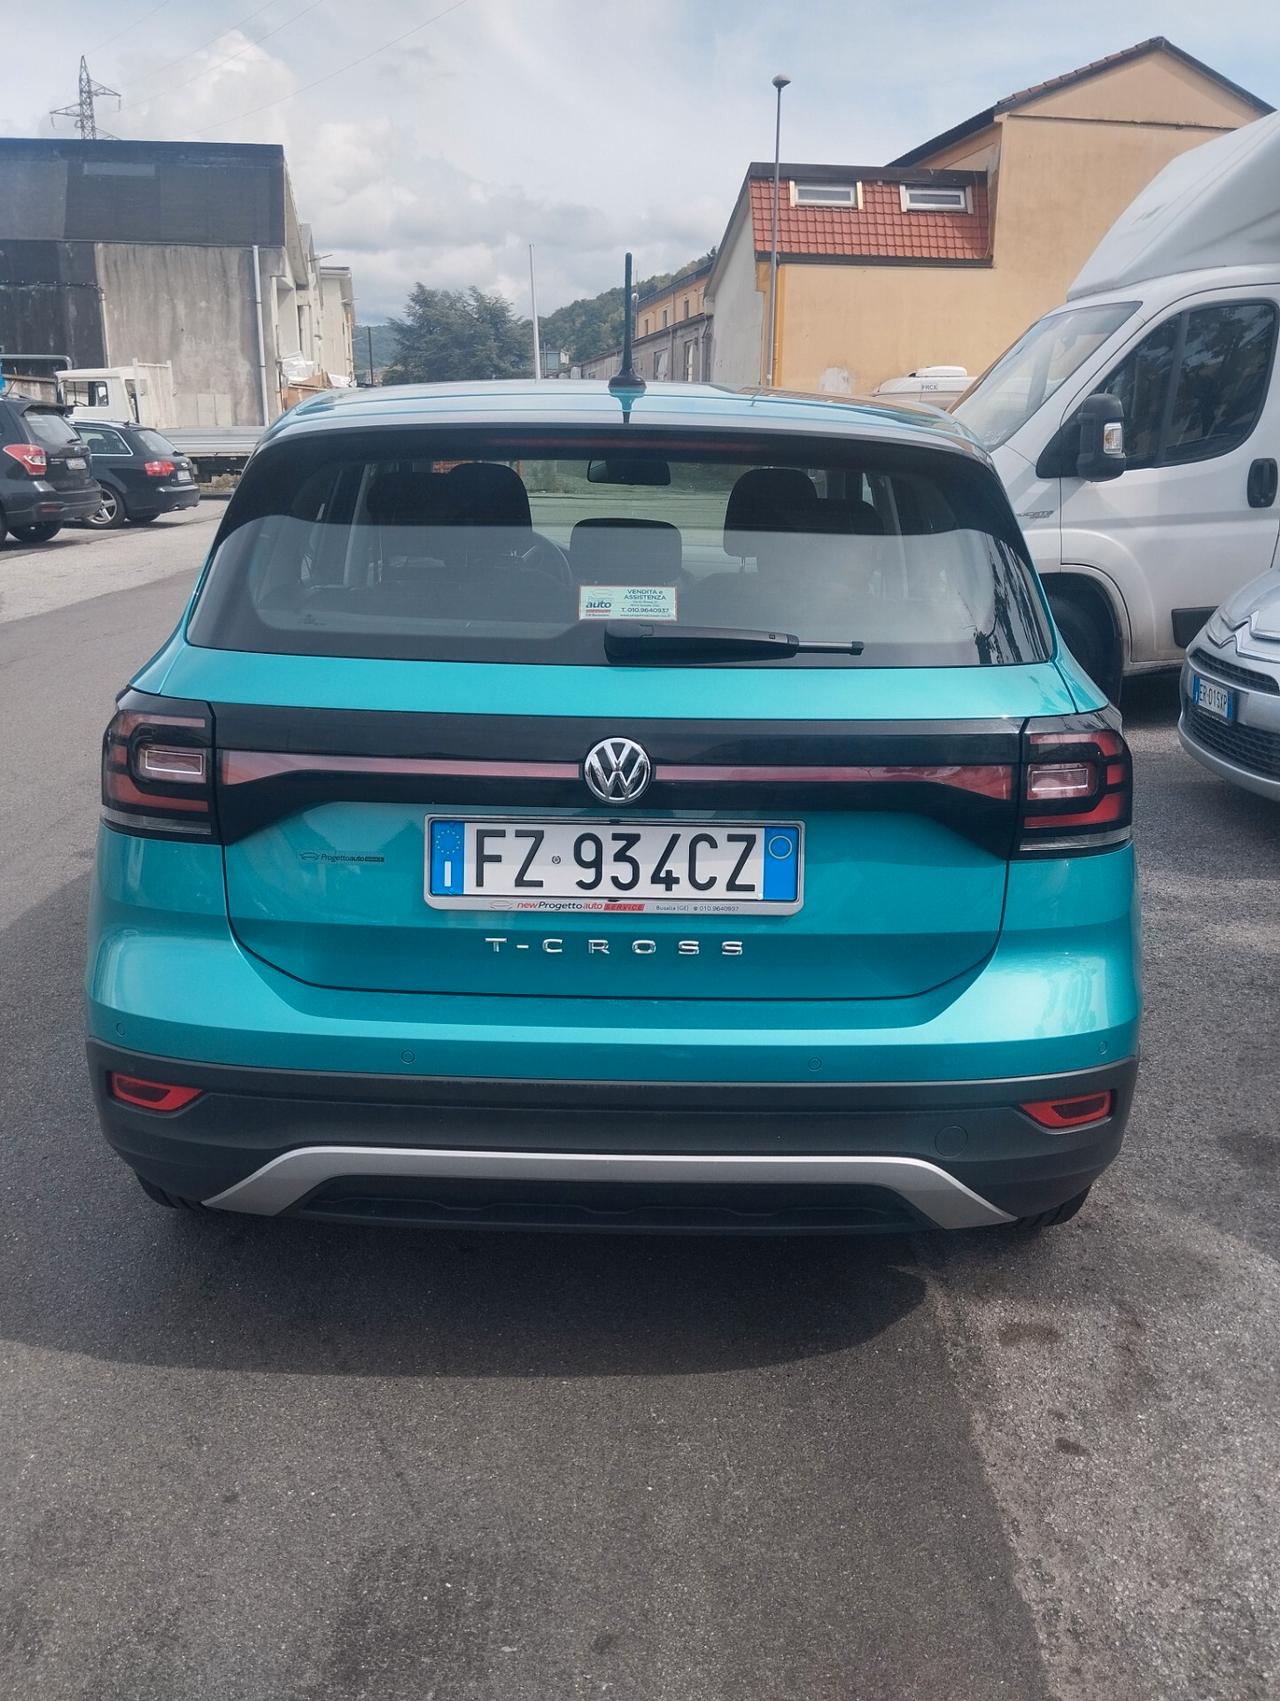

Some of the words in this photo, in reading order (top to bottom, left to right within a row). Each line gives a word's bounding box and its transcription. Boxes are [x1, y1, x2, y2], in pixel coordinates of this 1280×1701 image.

[585, 600, 612, 608] auto
[475, 829, 545, 888] FZ
[572, 832, 757, 892] 934CZ
[603, 903, 645, 911] SERVICE
